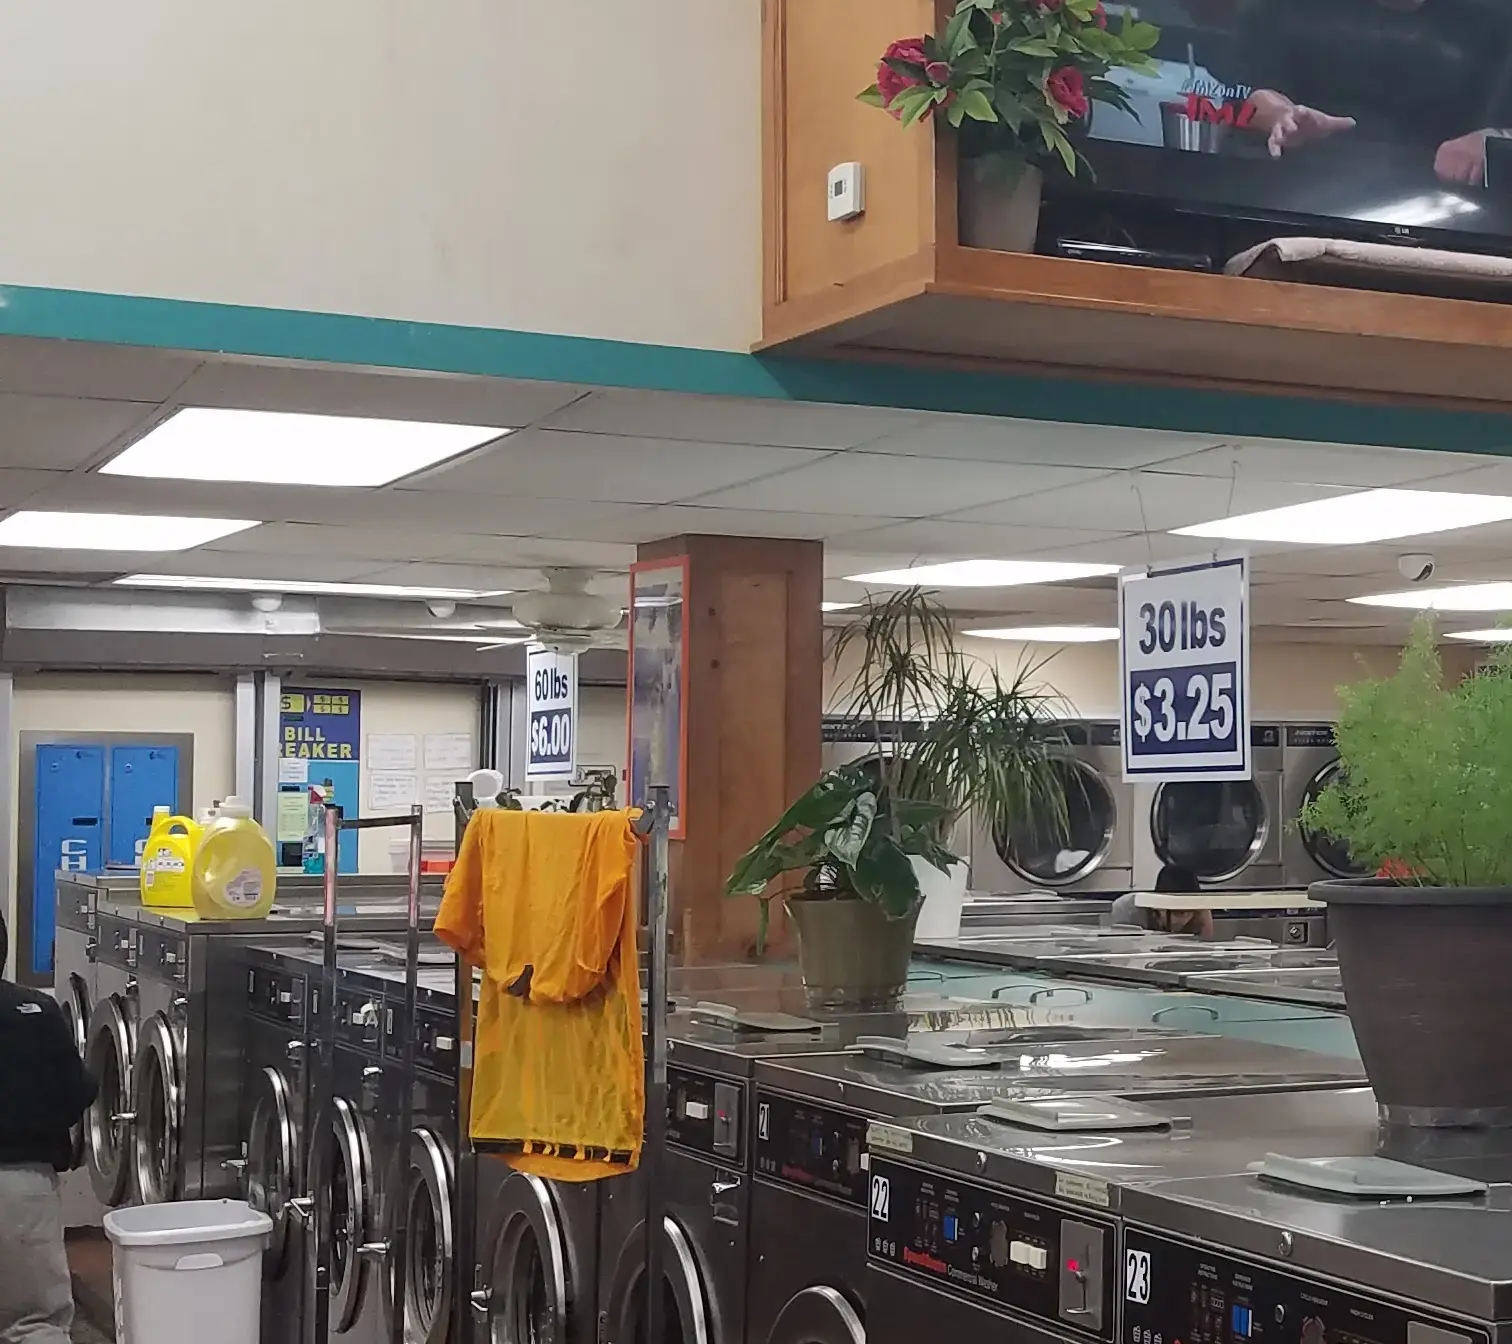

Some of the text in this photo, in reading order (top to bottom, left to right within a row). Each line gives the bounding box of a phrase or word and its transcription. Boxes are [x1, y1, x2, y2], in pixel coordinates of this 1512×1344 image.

[1133, 672, 1235, 743] $3.25
[284, 726, 326, 742] BILL
[531, 713, 570, 757] $6.00
[873, 1177, 888, 1219] 22
[1128, 1253, 1149, 1301] 23
